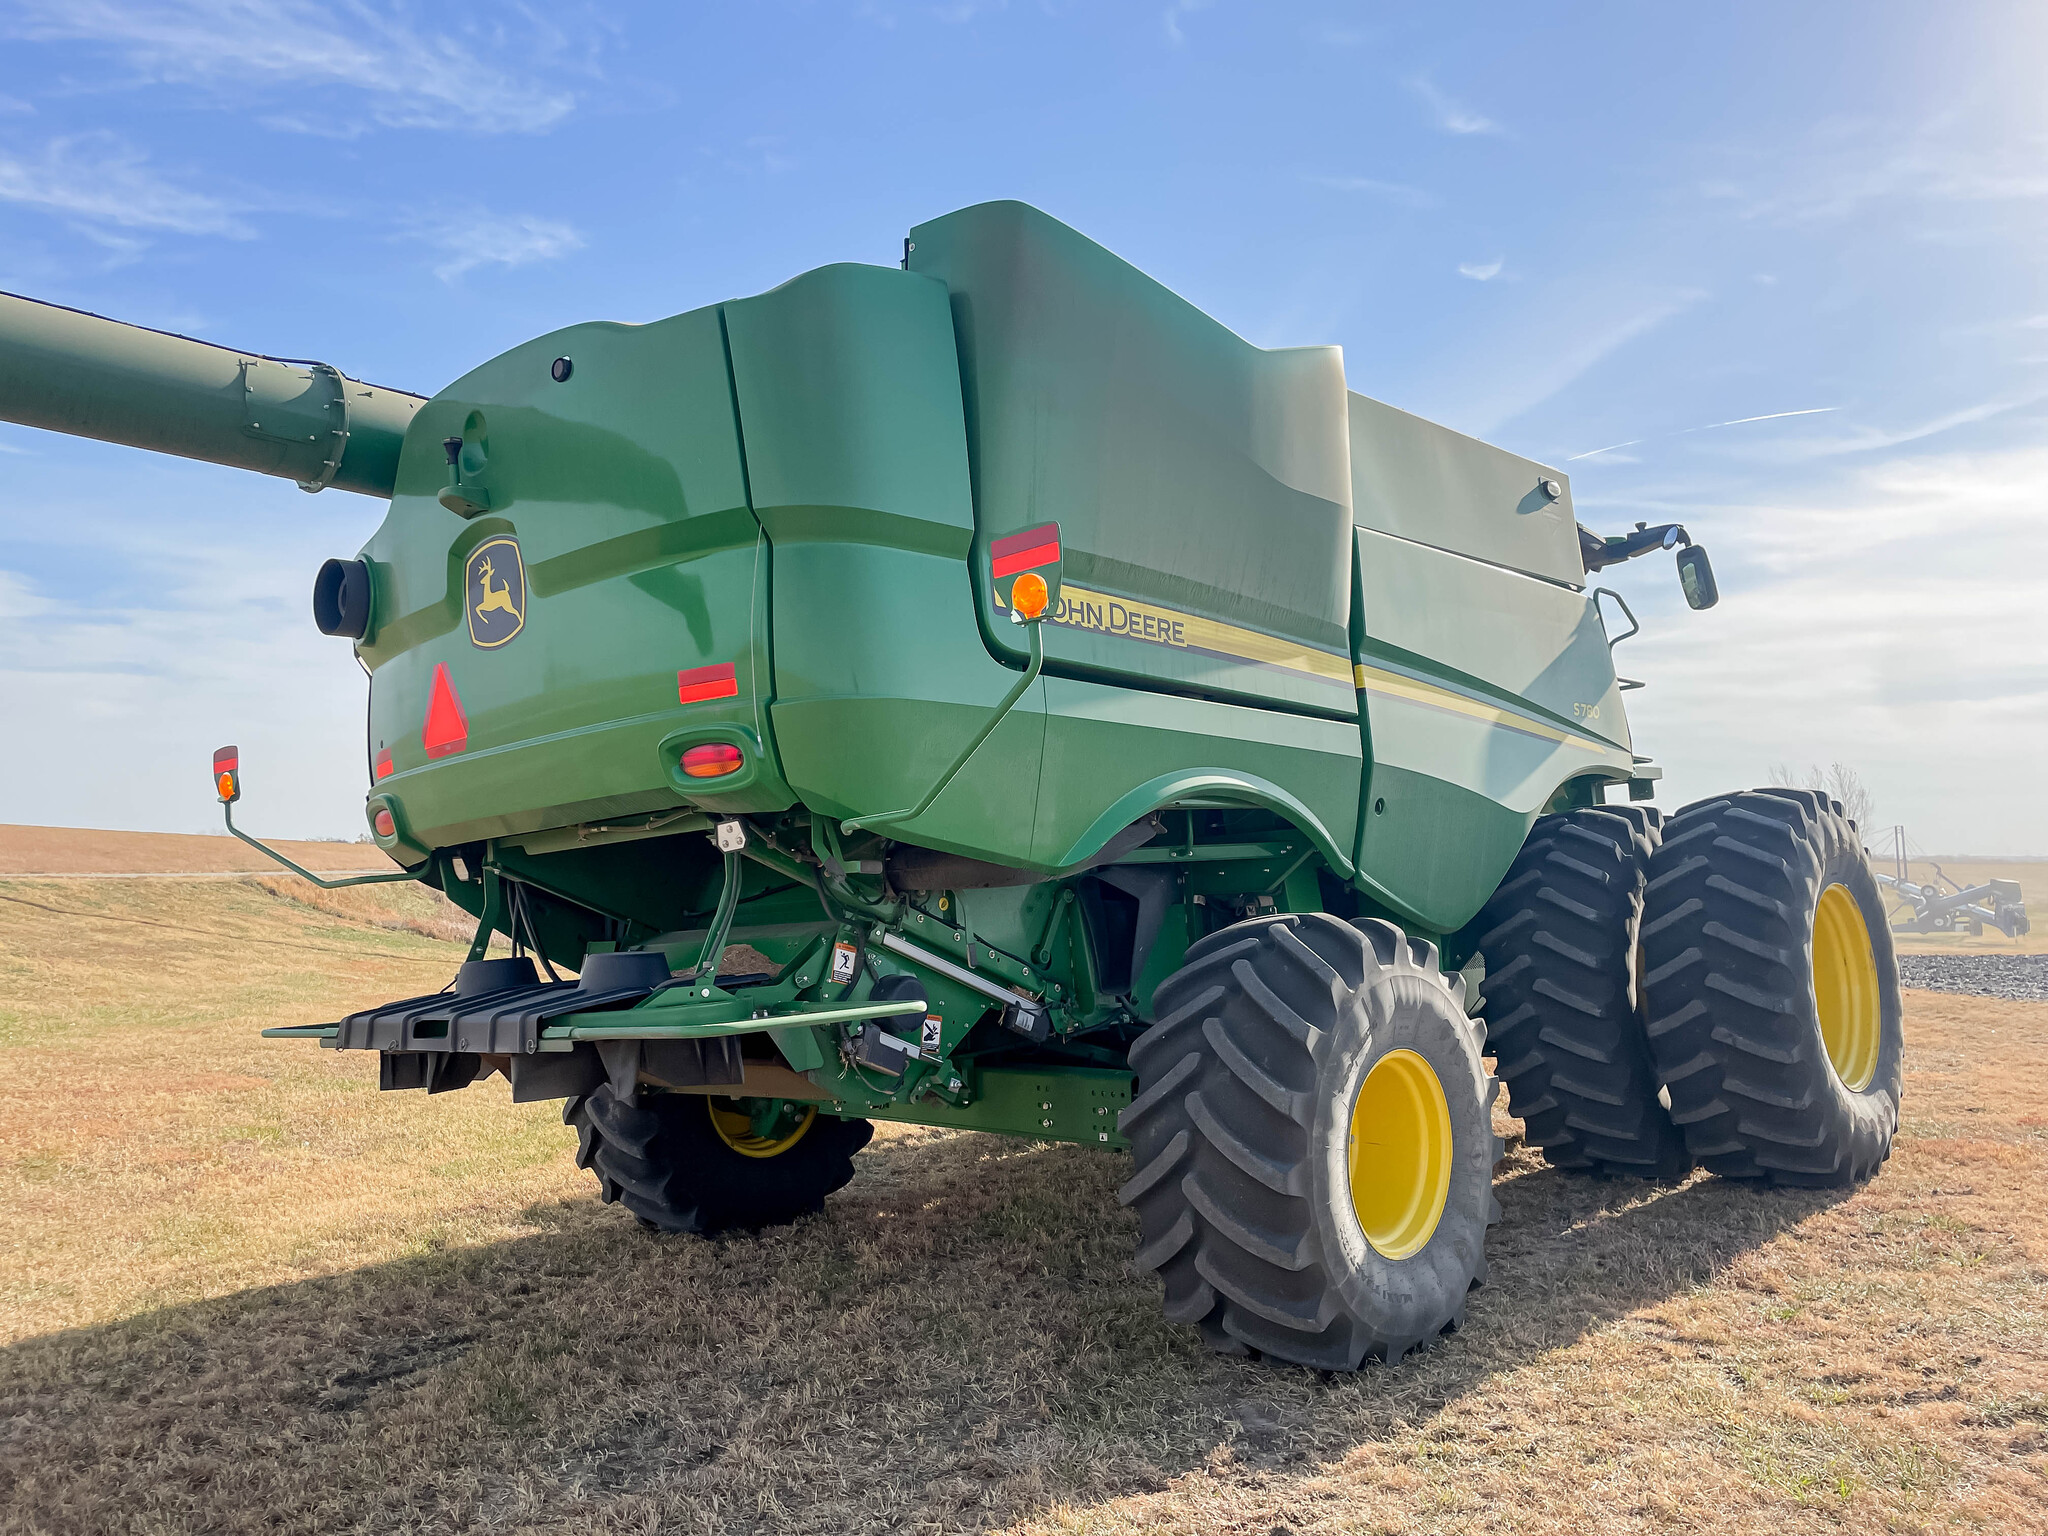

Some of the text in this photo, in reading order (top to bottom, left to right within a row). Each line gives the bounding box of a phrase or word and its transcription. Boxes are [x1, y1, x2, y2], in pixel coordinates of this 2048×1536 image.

[1054, 596, 1185, 643] OHN DEERE
[1573, 702, 1600, 719] S780
